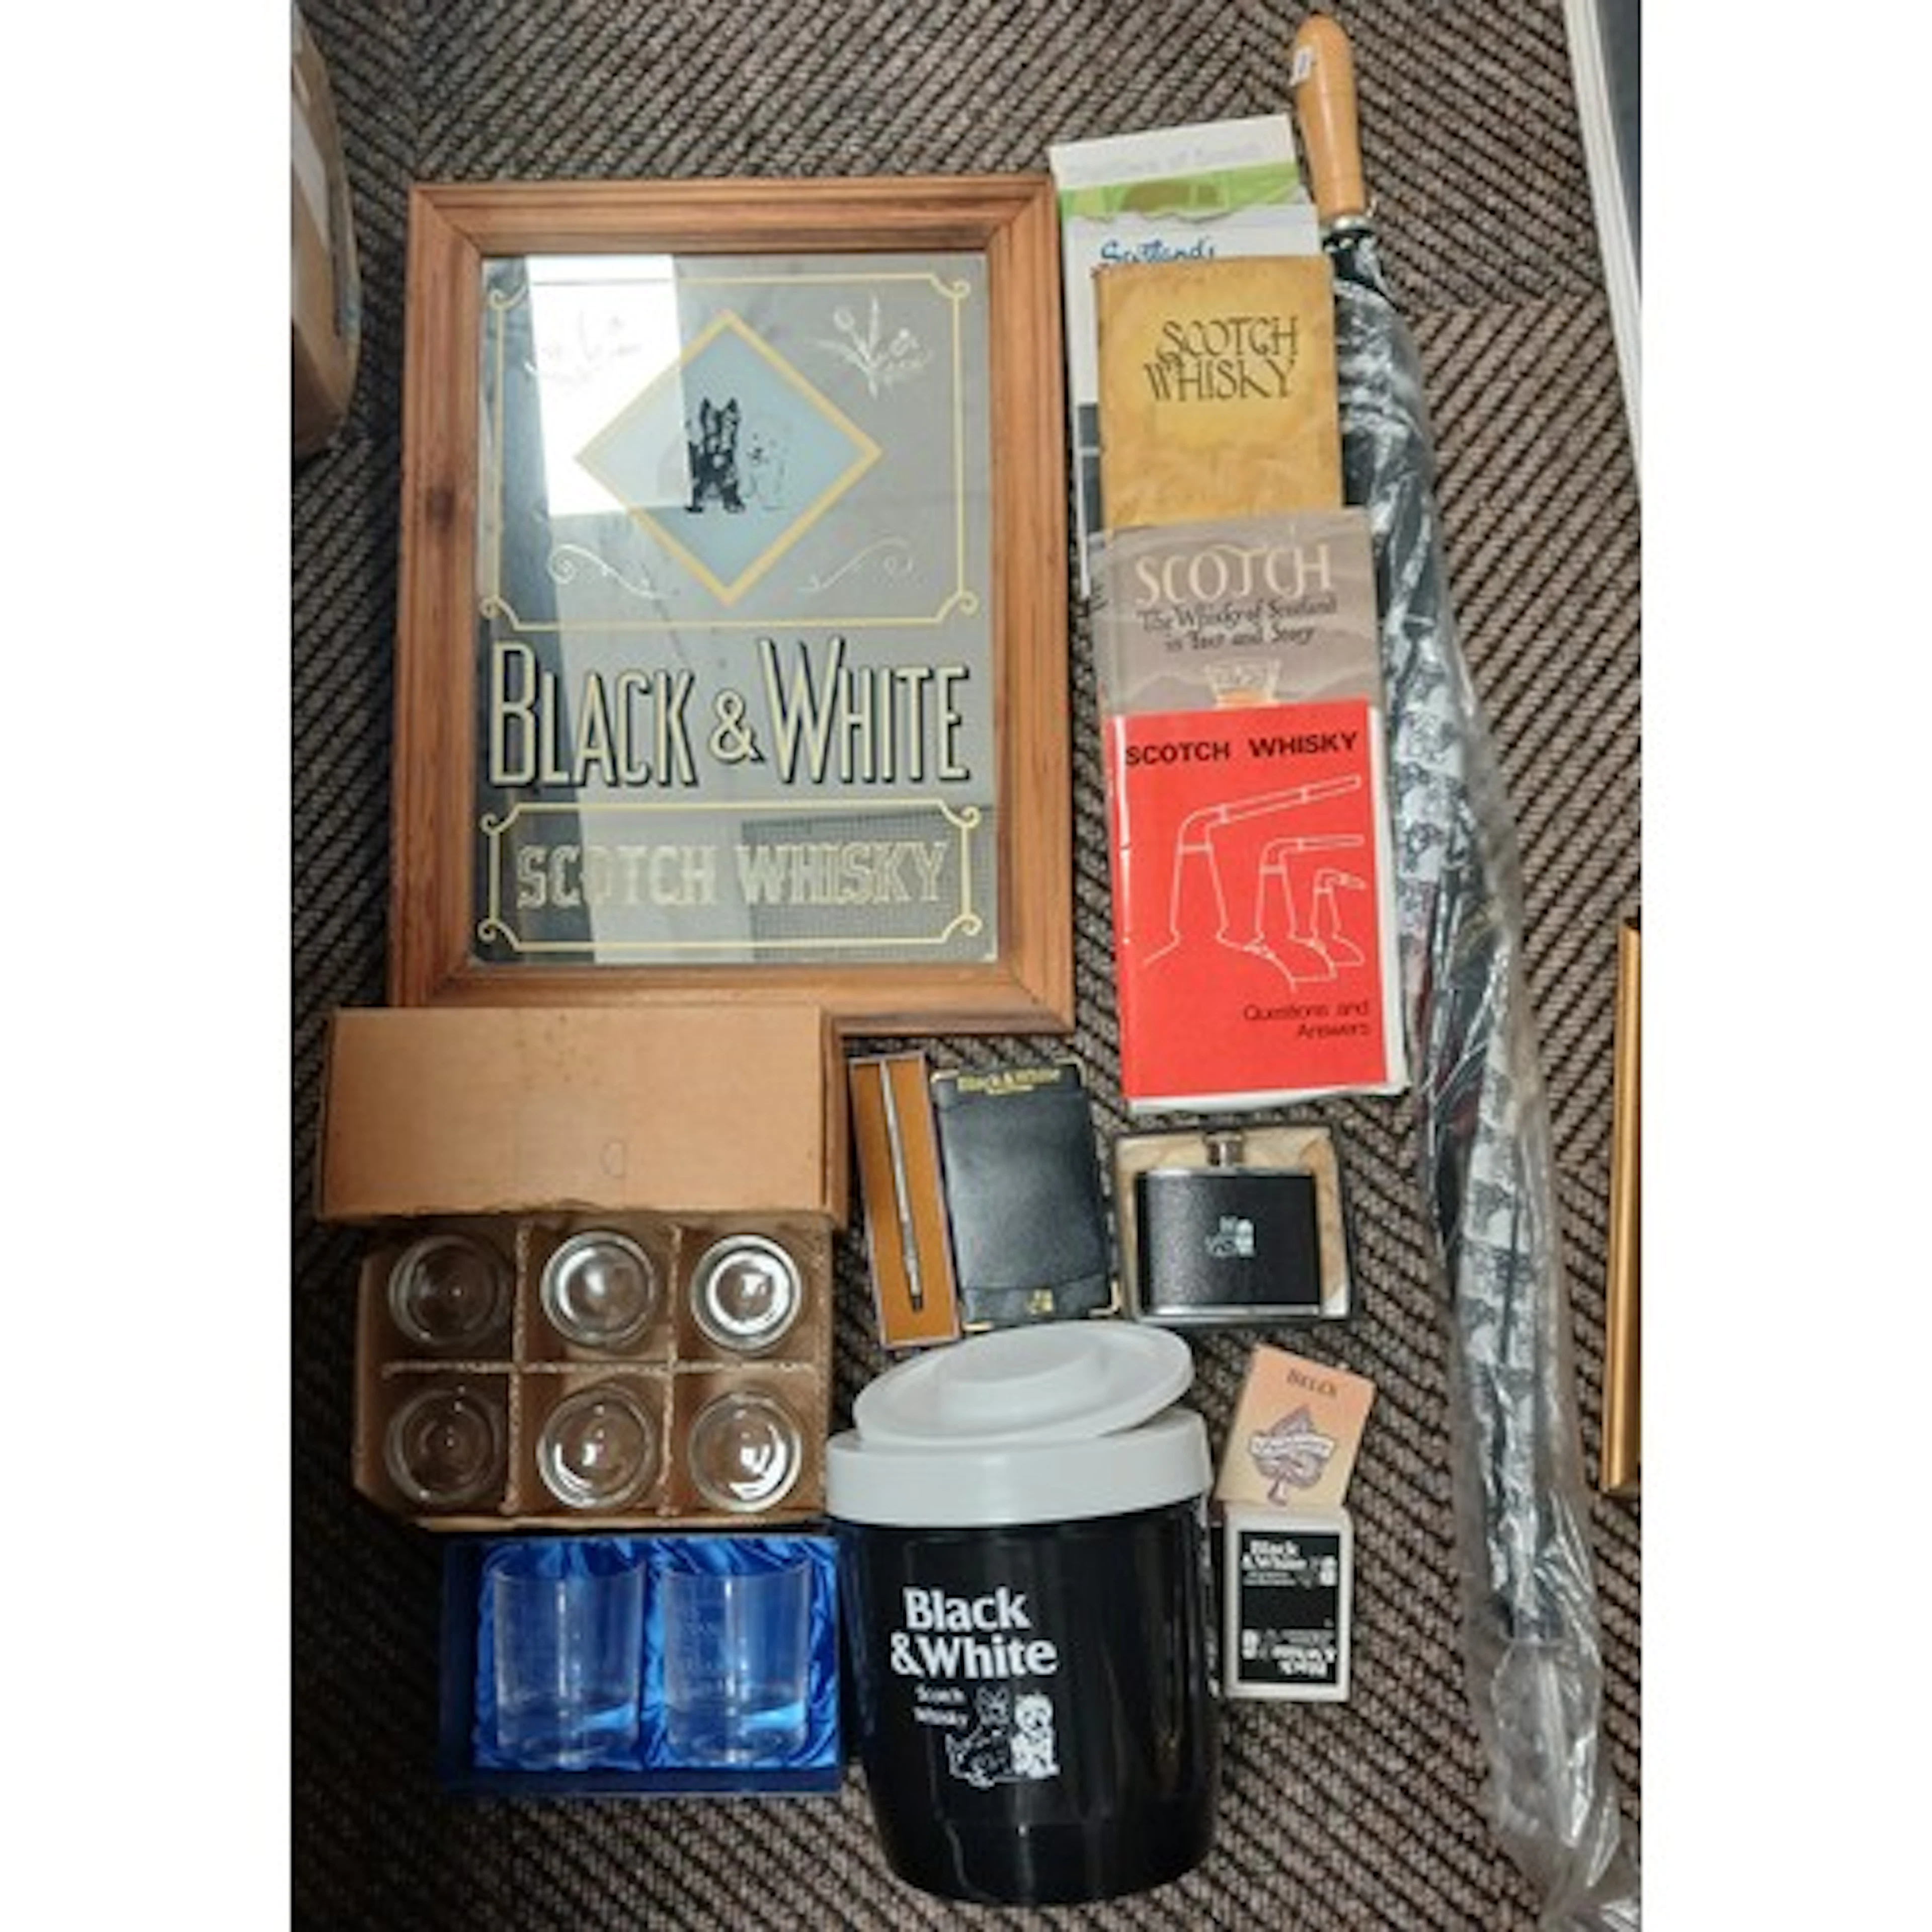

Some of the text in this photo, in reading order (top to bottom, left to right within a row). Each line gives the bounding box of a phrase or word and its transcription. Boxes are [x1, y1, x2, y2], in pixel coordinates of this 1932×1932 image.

[1160, 315, 1299, 356] SCOTCH
[1143, 353, 1296, 402] WHISKY
[1135, 543, 1332, 606] SCOTCH
[489, 636, 971, 788] BLACK & WHITE
[1125, 731, 1357, 766] SCOTCH WHISKY
[516, 839, 950, 909] SCOTCH WHISKY
[903, 1586, 1033, 1632] Black
